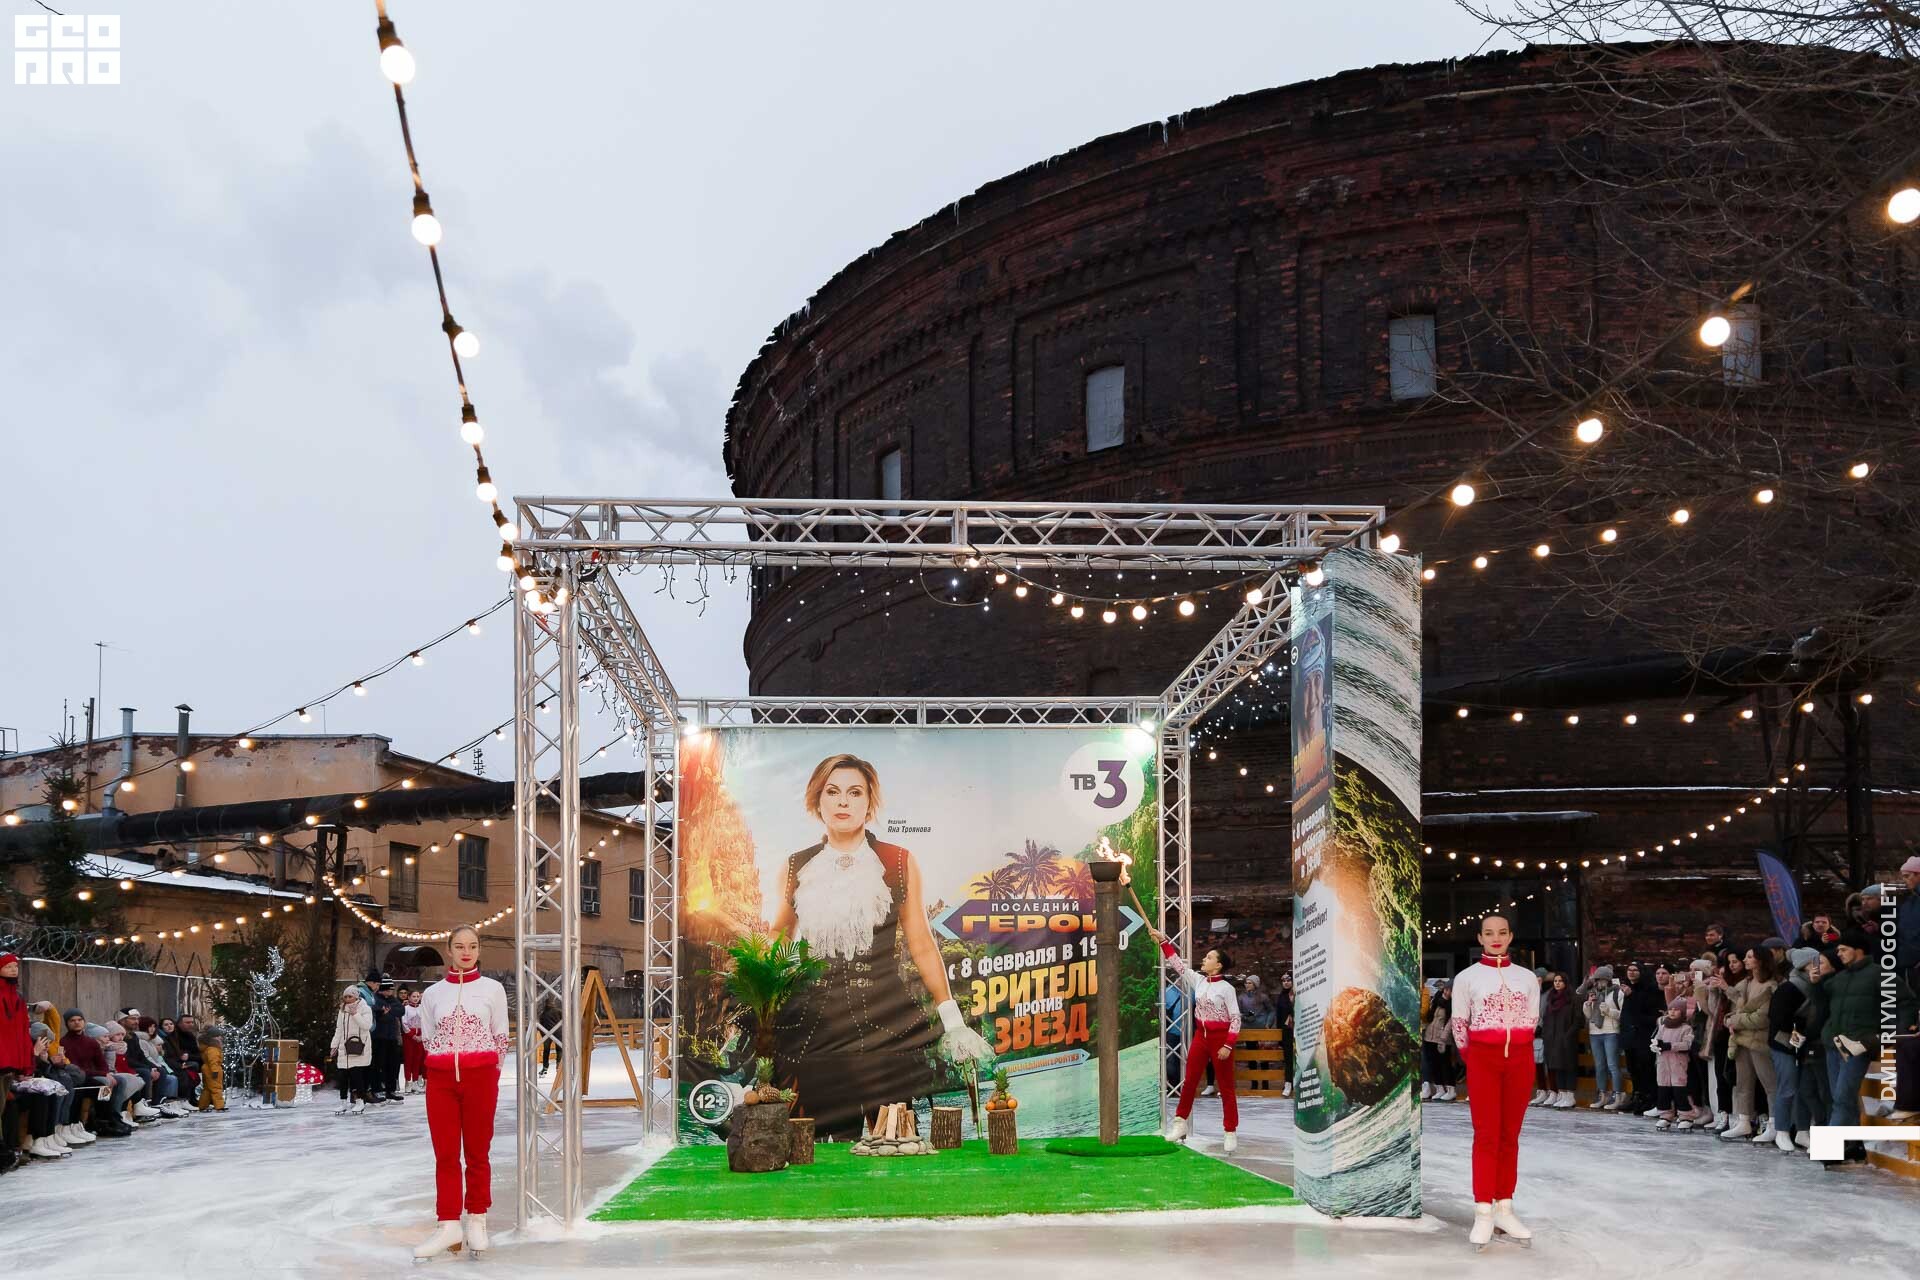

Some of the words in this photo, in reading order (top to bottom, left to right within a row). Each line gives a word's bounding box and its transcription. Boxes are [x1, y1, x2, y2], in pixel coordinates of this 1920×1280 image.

[992, 900, 1080, 912] ПОСЛЕДНИЙ
[960, 958, 972, 978] 8
[978, 946, 1056, 976] февраля
[1062, 943, 1074, 960] в
[994, 1002, 1090, 1054] ЗВЕЗД
[696, 1093, 726, 1109] 12+
